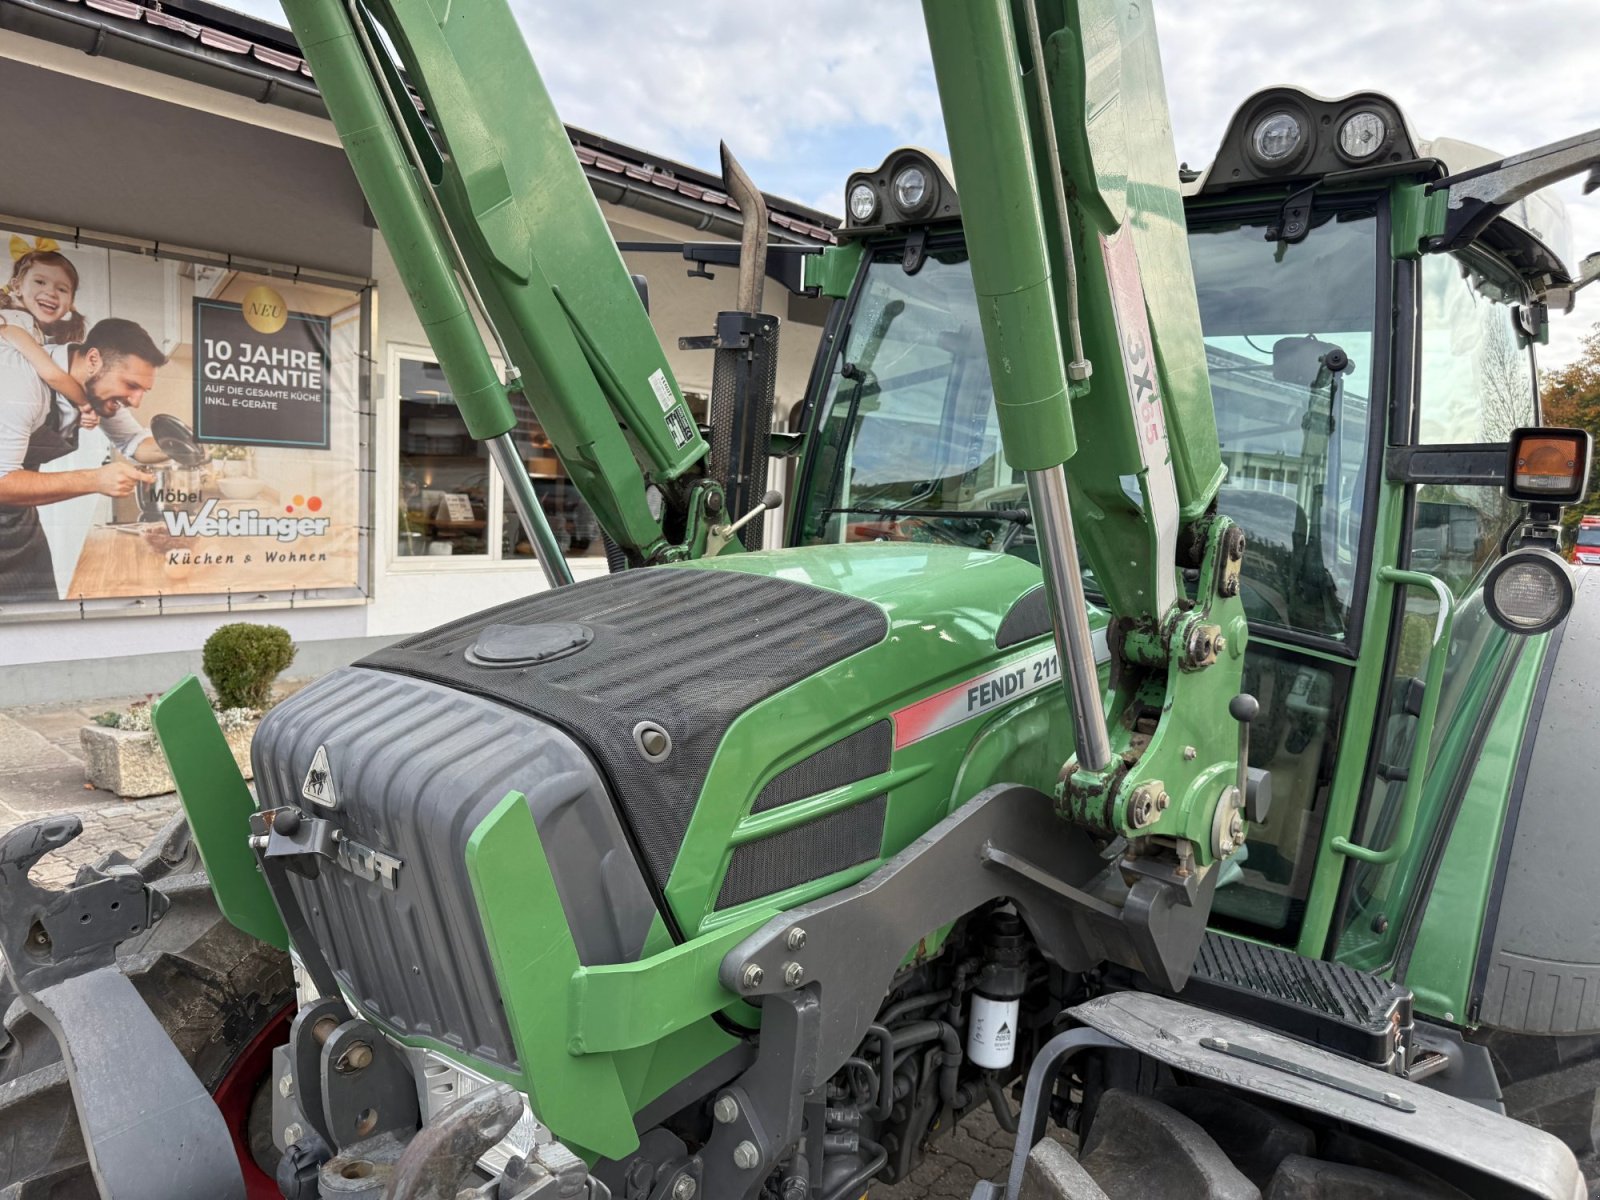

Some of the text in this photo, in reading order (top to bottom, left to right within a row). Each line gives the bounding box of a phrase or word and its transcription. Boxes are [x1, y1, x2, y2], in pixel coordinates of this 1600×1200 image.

[248, 302, 283, 319] NEU
[204, 338, 321, 371] 10 JAHRE
[204, 361, 321, 390] GARANTIE
[205, 384, 321, 403] AUF DIE GESAMTE KÜCHE
[205, 396, 278, 410] INKL. E-GERÄTE
[150, 489, 203, 503] Möbel
[163, 499, 330, 542] Weidinger
[168, 552, 235, 565] Küchen
[265, 551, 327, 563] Wohnen
[967, 668, 1026, 712] FENDT
